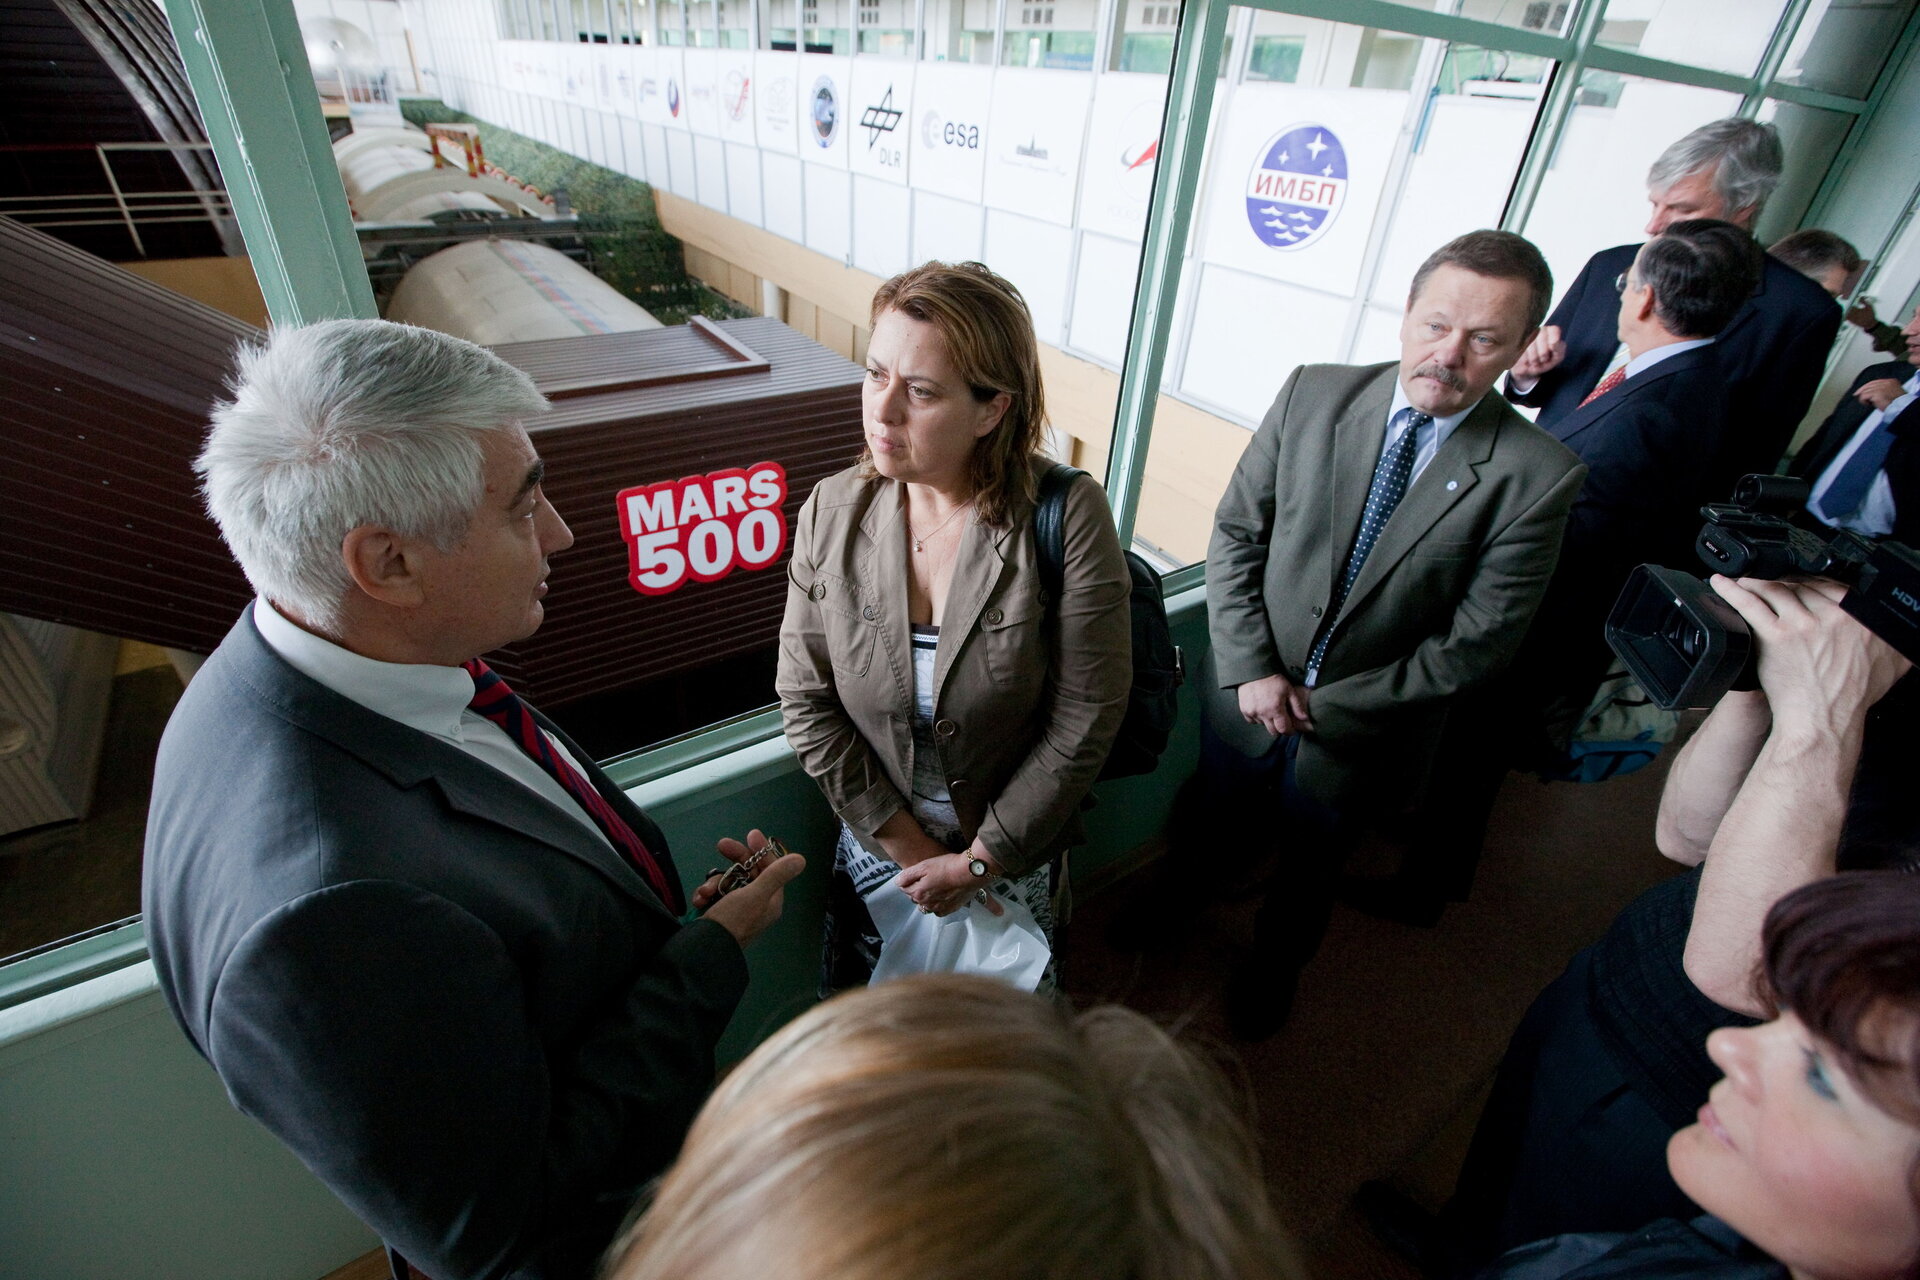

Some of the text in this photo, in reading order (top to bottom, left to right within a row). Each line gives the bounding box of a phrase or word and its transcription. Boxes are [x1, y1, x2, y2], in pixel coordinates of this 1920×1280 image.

[944, 122, 979, 149] esa
[879, 147, 901, 168] DLR
[1255, 173, 1337, 206] ИМБП
[626, 469, 781, 536] MARS
[637, 509, 781, 588] 500
[1891, 586, 1920, 613] HDV
